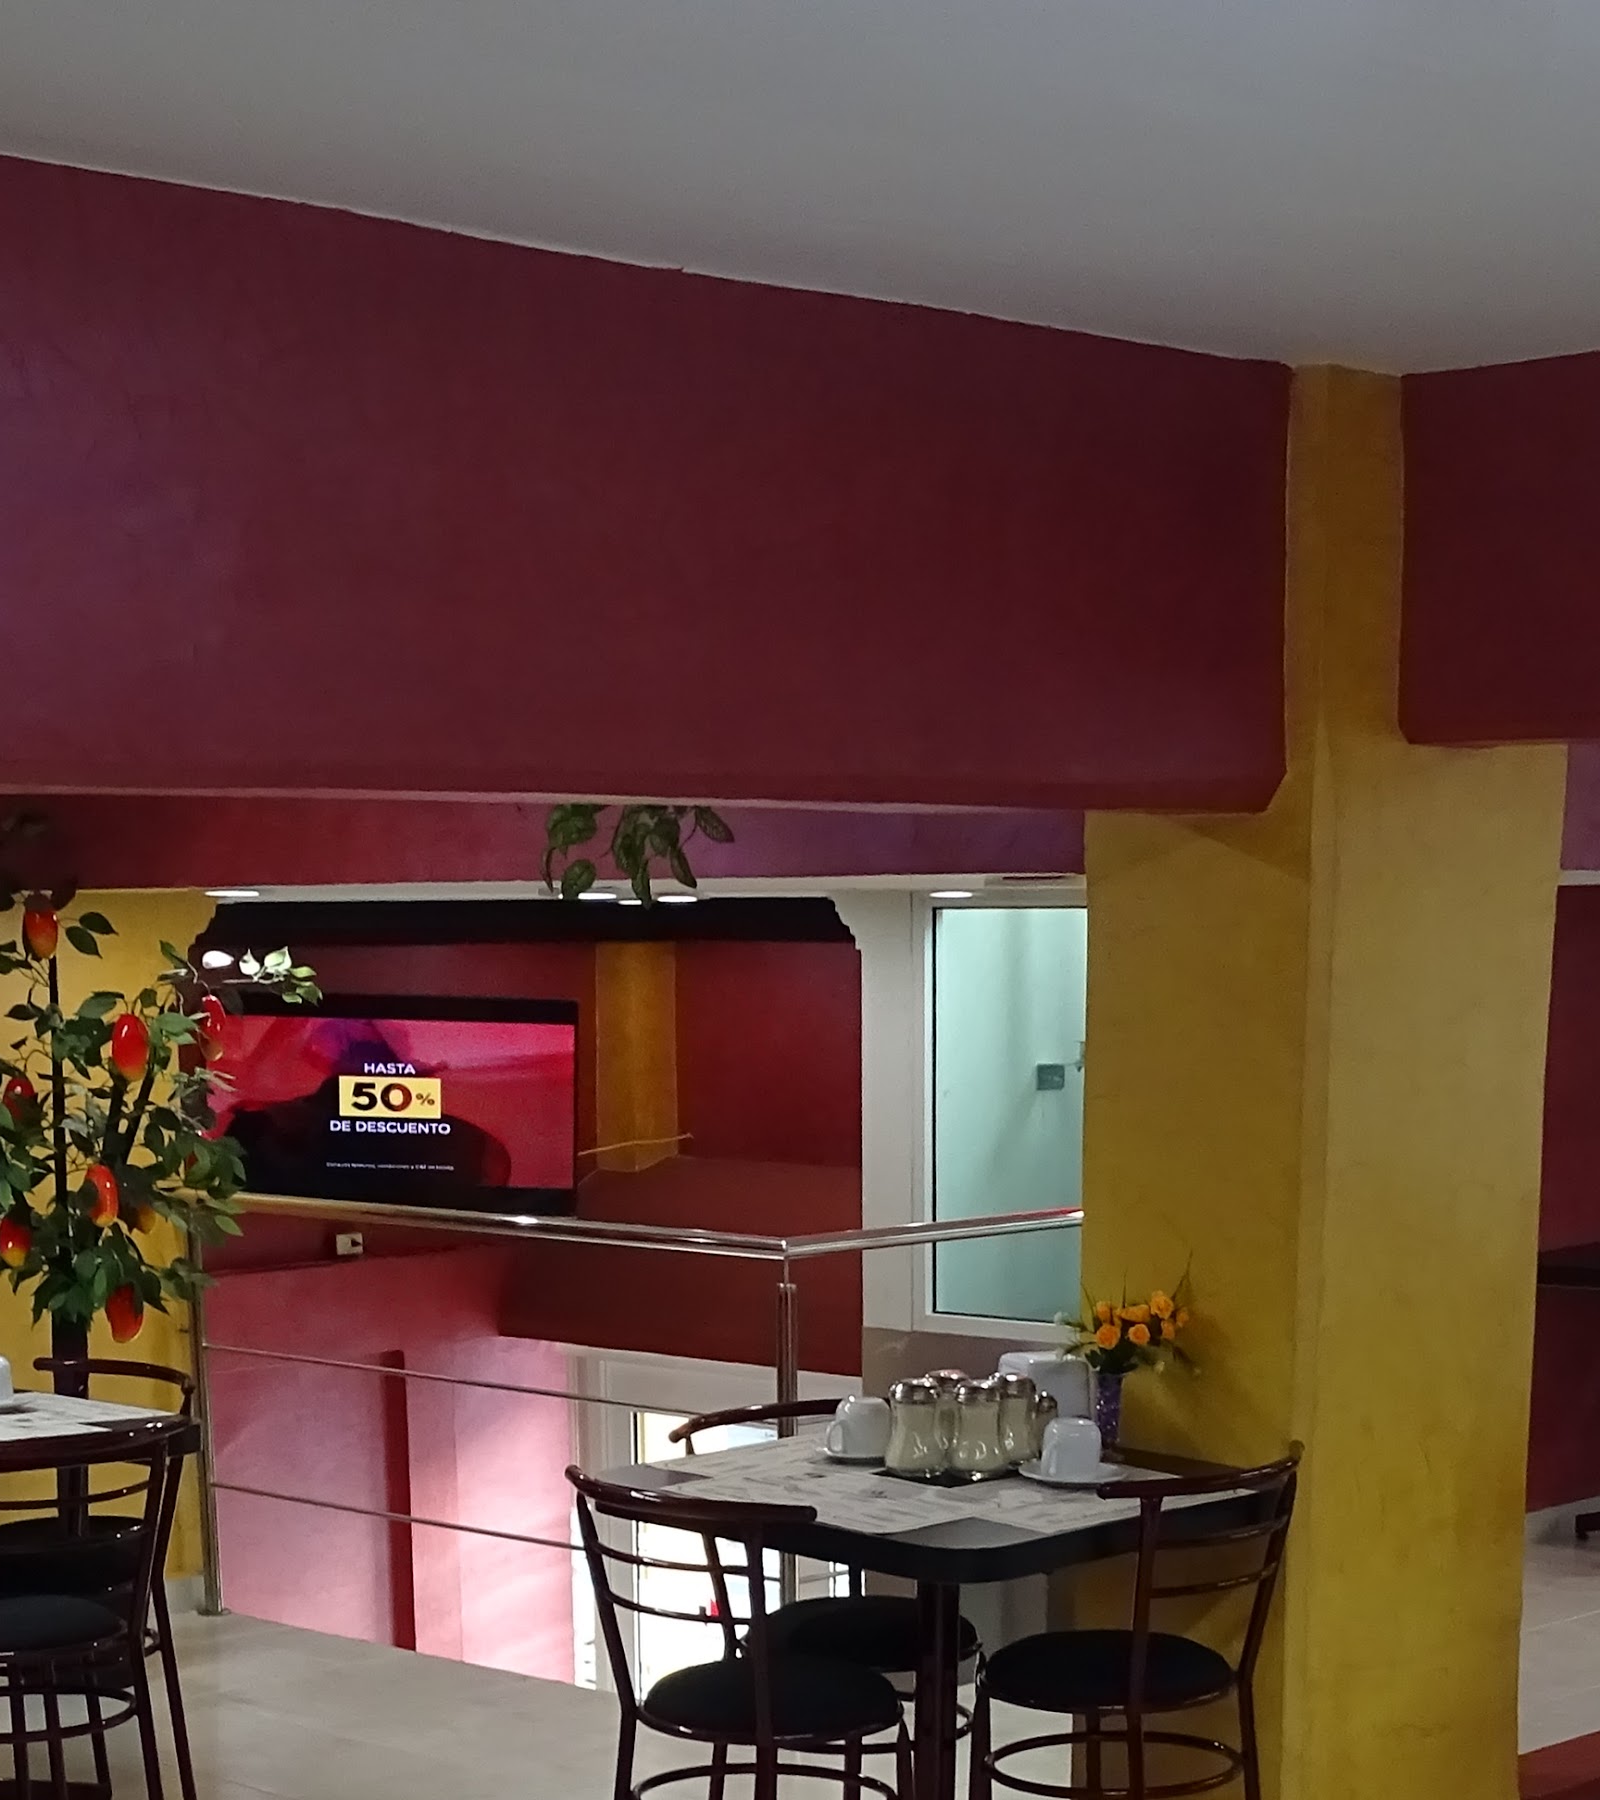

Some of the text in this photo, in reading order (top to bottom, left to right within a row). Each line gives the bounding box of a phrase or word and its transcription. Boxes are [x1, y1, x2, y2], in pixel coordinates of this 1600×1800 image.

[364, 1063, 416, 1075] HASTA
[351, 1082, 435, 1112] 50%
[330, 1120, 451, 1135] DE DESCUENTO
